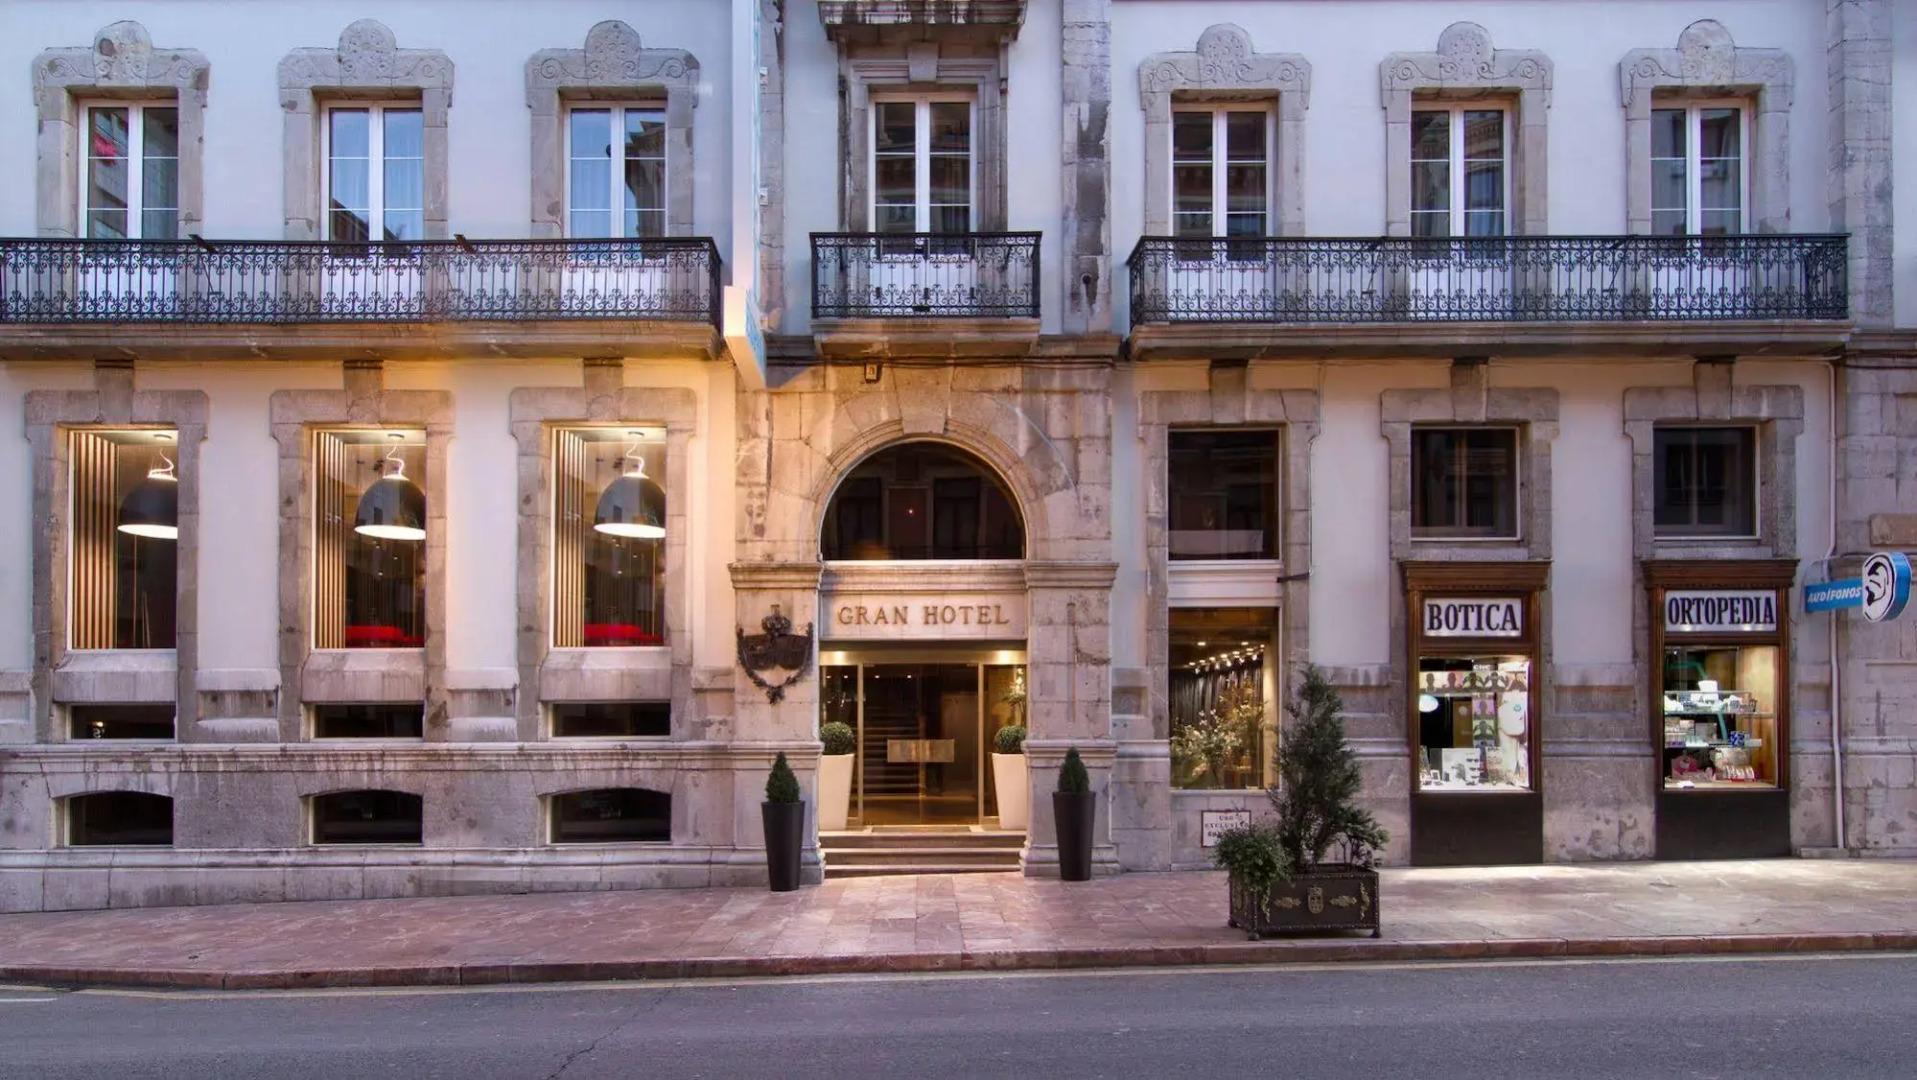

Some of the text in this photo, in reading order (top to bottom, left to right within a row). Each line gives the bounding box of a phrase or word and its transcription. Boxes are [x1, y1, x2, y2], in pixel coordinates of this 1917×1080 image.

[1807, 586, 1863, 603] AUDÍFONOS
[838, 605, 1010, 625] GRAN HOTEL
[1427, 603, 1519, 631] BOTICA
[1668, 597, 1775, 625] ORTOPEDIA
